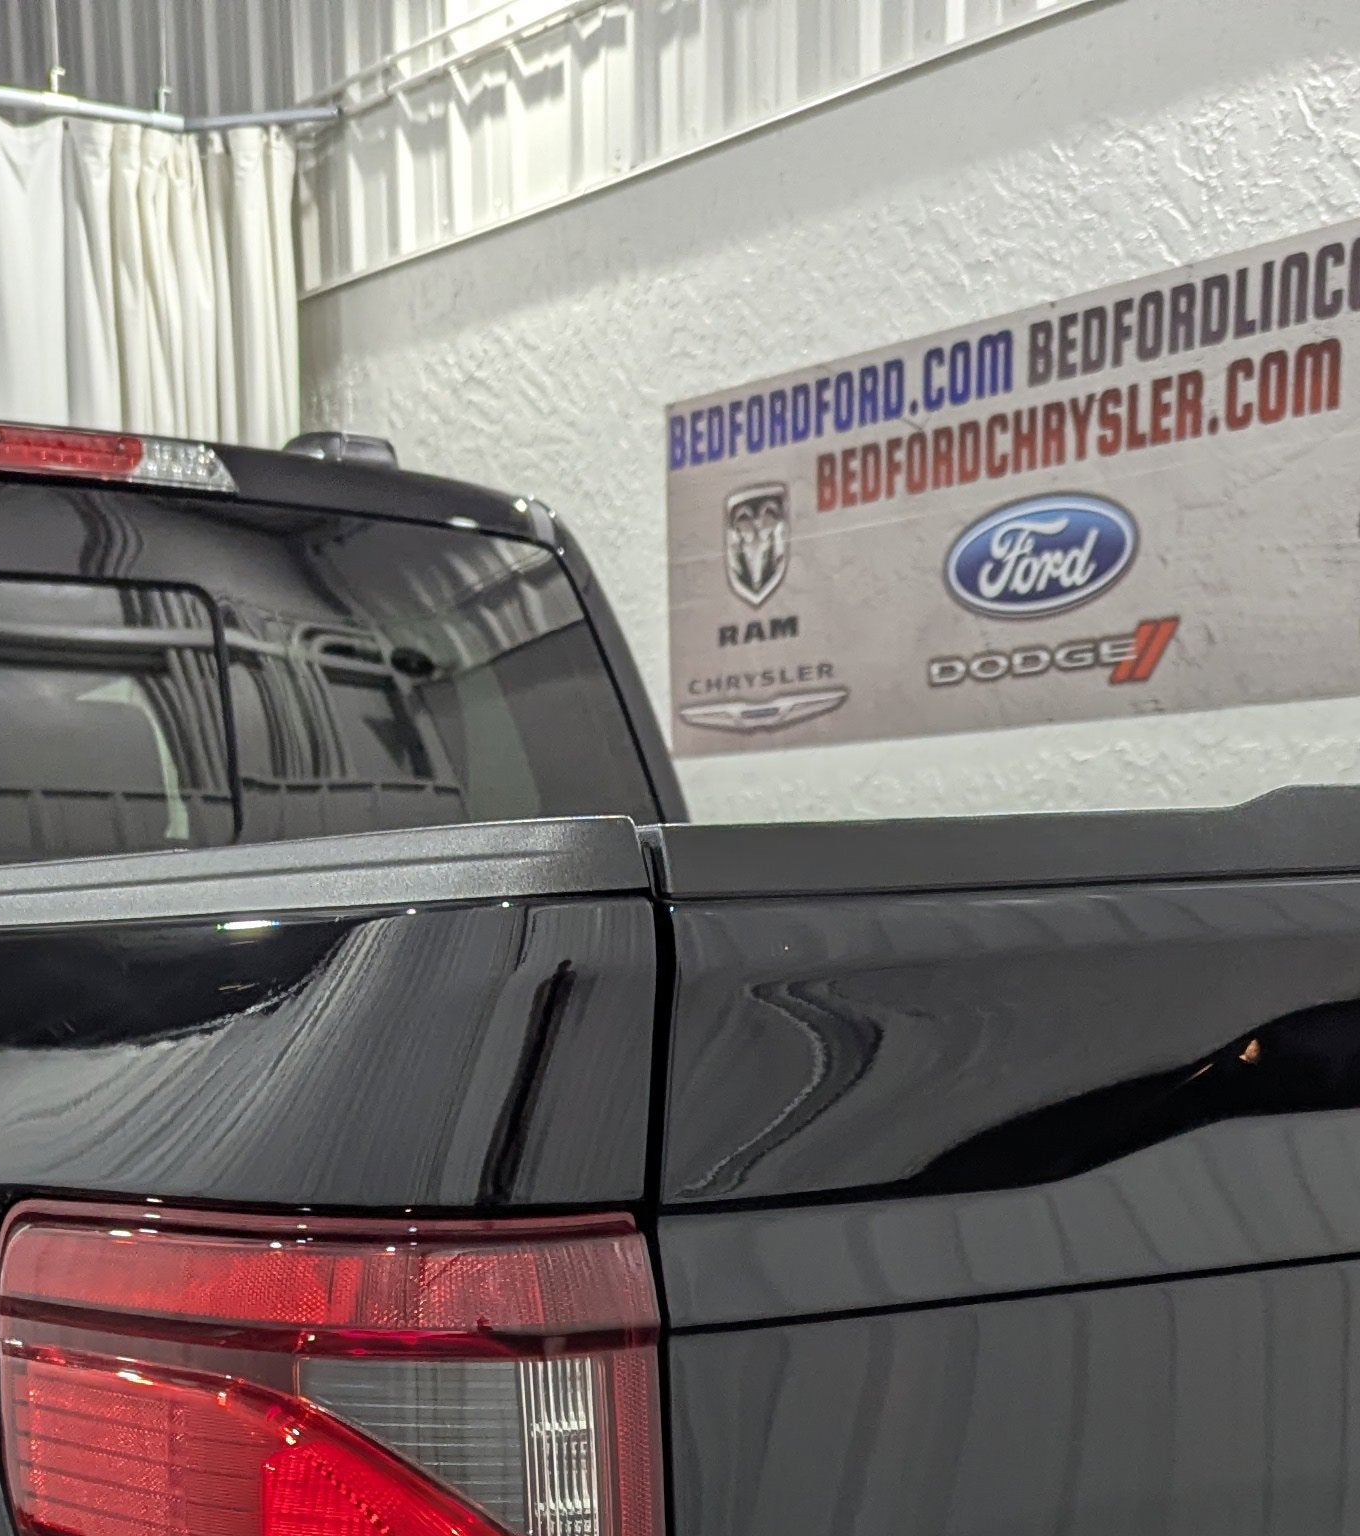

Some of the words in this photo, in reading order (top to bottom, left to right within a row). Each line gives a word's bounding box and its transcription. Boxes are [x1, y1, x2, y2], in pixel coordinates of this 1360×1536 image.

[669, 325, 1013, 469] BEDFORDFORD.COM
[816, 338, 1342, 512] BEDFORDCHRYSLER.COM
[978, 516, 1098, 599] Ford
[718, 615, 799, 647] RAM
[927, 633, 1139, 687] DODGE
[688, 663, 835, 695] CHRYSLER
